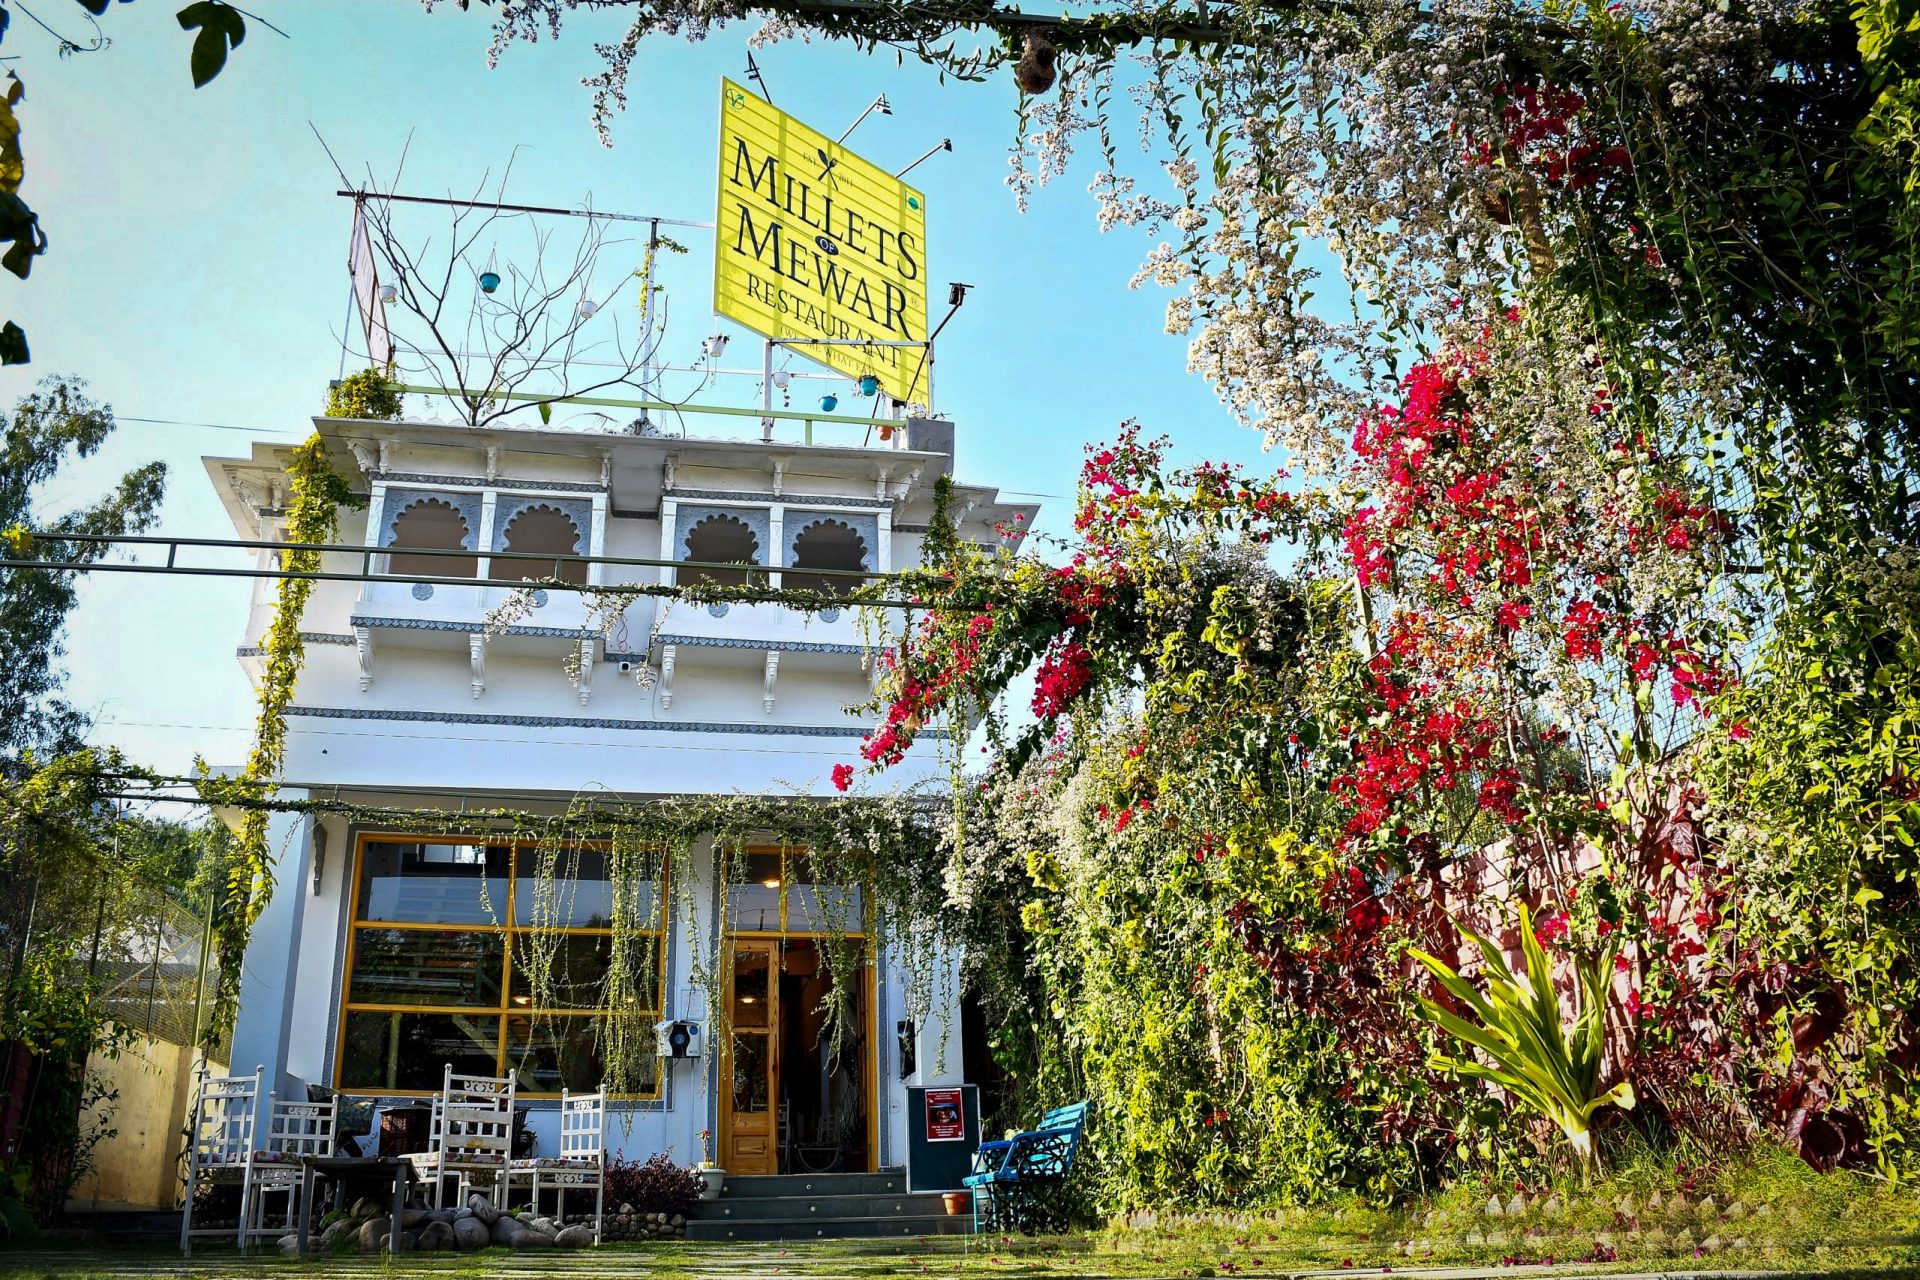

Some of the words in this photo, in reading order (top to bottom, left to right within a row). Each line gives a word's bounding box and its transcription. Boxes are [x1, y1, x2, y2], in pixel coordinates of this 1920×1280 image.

[729, 136, 917, 281] MILLETS
[819, 238, 835, 252] OF
[732, 202, 914, 342] MEWAR
[746, 272, 902, 369] RESTAURANT
